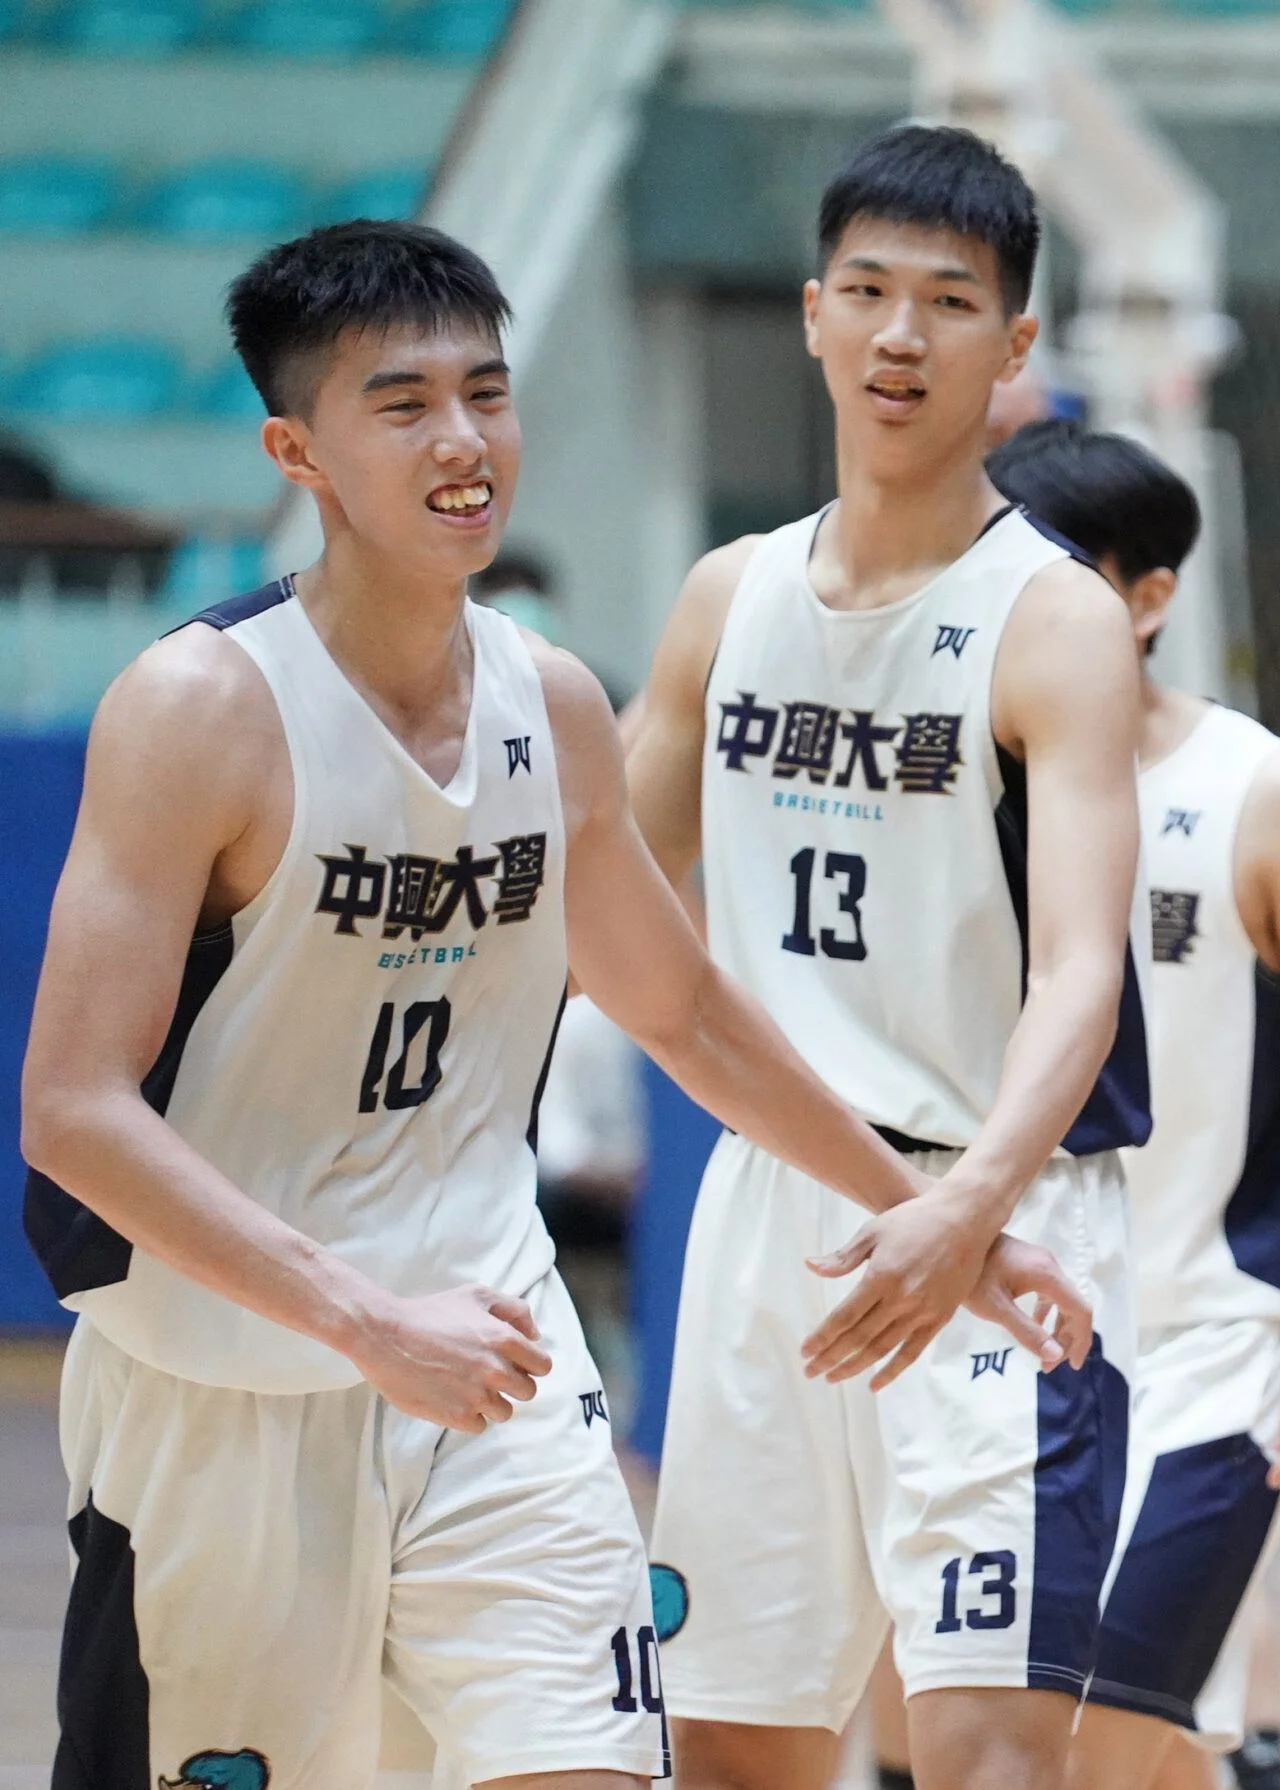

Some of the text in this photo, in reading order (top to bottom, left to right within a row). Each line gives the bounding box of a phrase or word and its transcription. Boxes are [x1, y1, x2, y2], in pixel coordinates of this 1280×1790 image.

[716, 690, 967, 796] 中興大學
[313, 832, 547, 943] 中興大學
[781, 847, 868, 962] 13
[358, 994, 452, 1114] 10
[935, 1549, 1017, 1634] 13
[611, 1625, 664, 1713] 10
